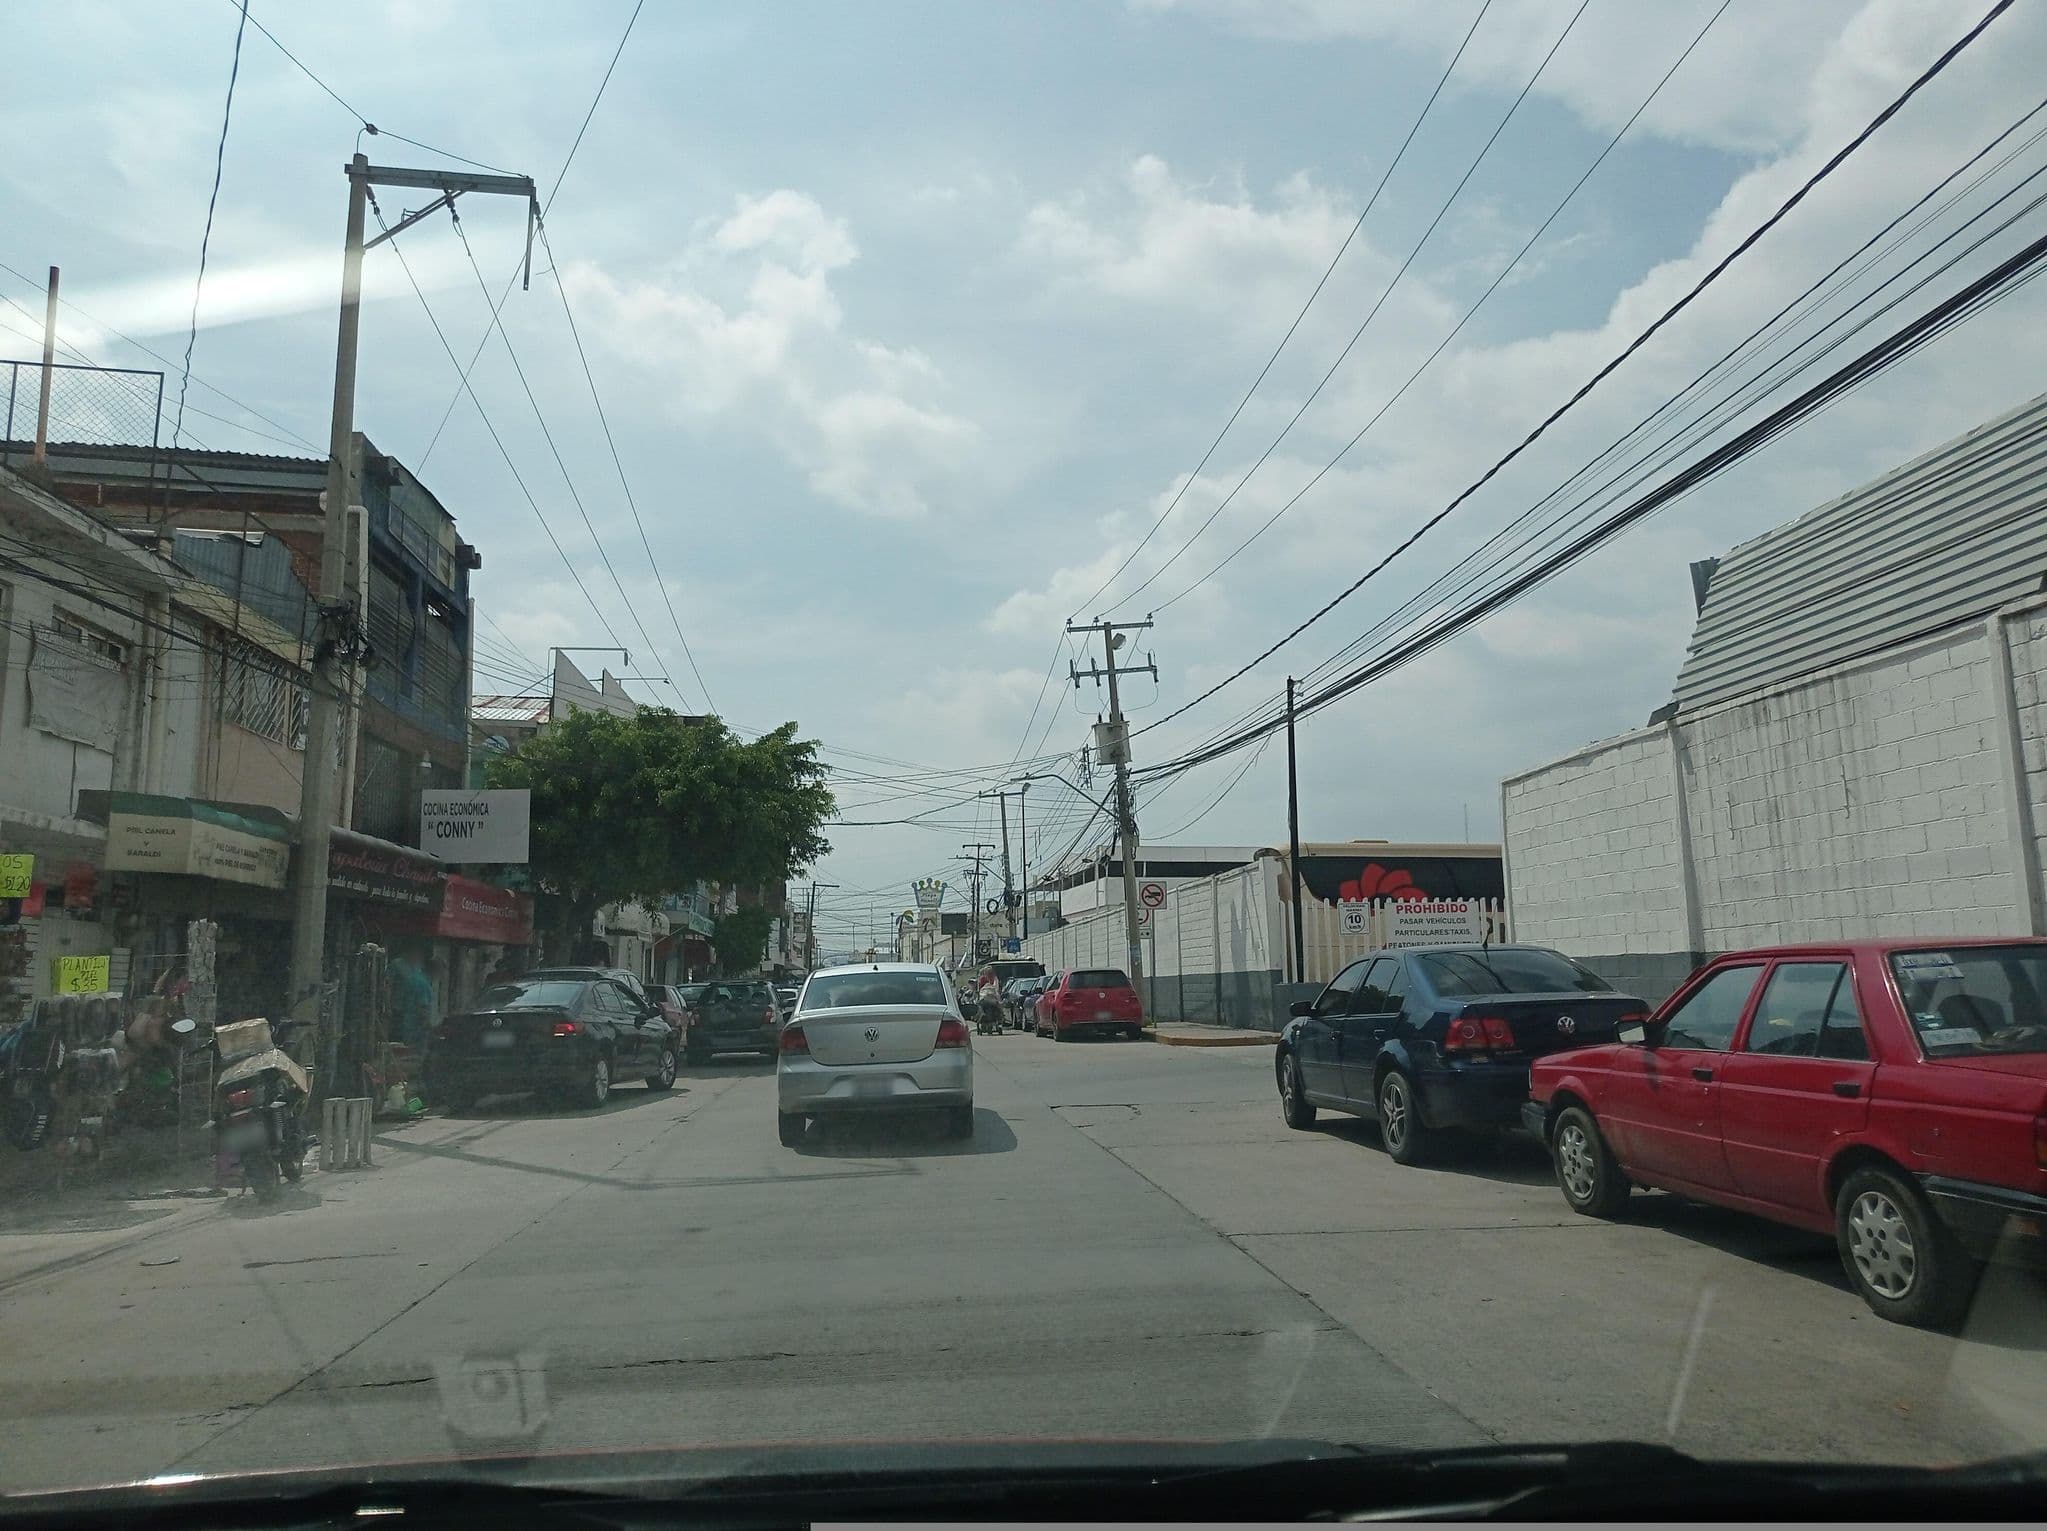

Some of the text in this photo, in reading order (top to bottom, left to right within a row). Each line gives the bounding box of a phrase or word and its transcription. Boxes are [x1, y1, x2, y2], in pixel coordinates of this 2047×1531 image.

[423, 800, 489, 816] COCINA ECONÓMICA
[143, 840, 150, 848] Y
[2, 875, 31, 891] $120
[1395, 903, 1468, 914] PROHIBIDO
[1347, 914, 1361, 924] 10
[70, 977, 98, 993] $35
